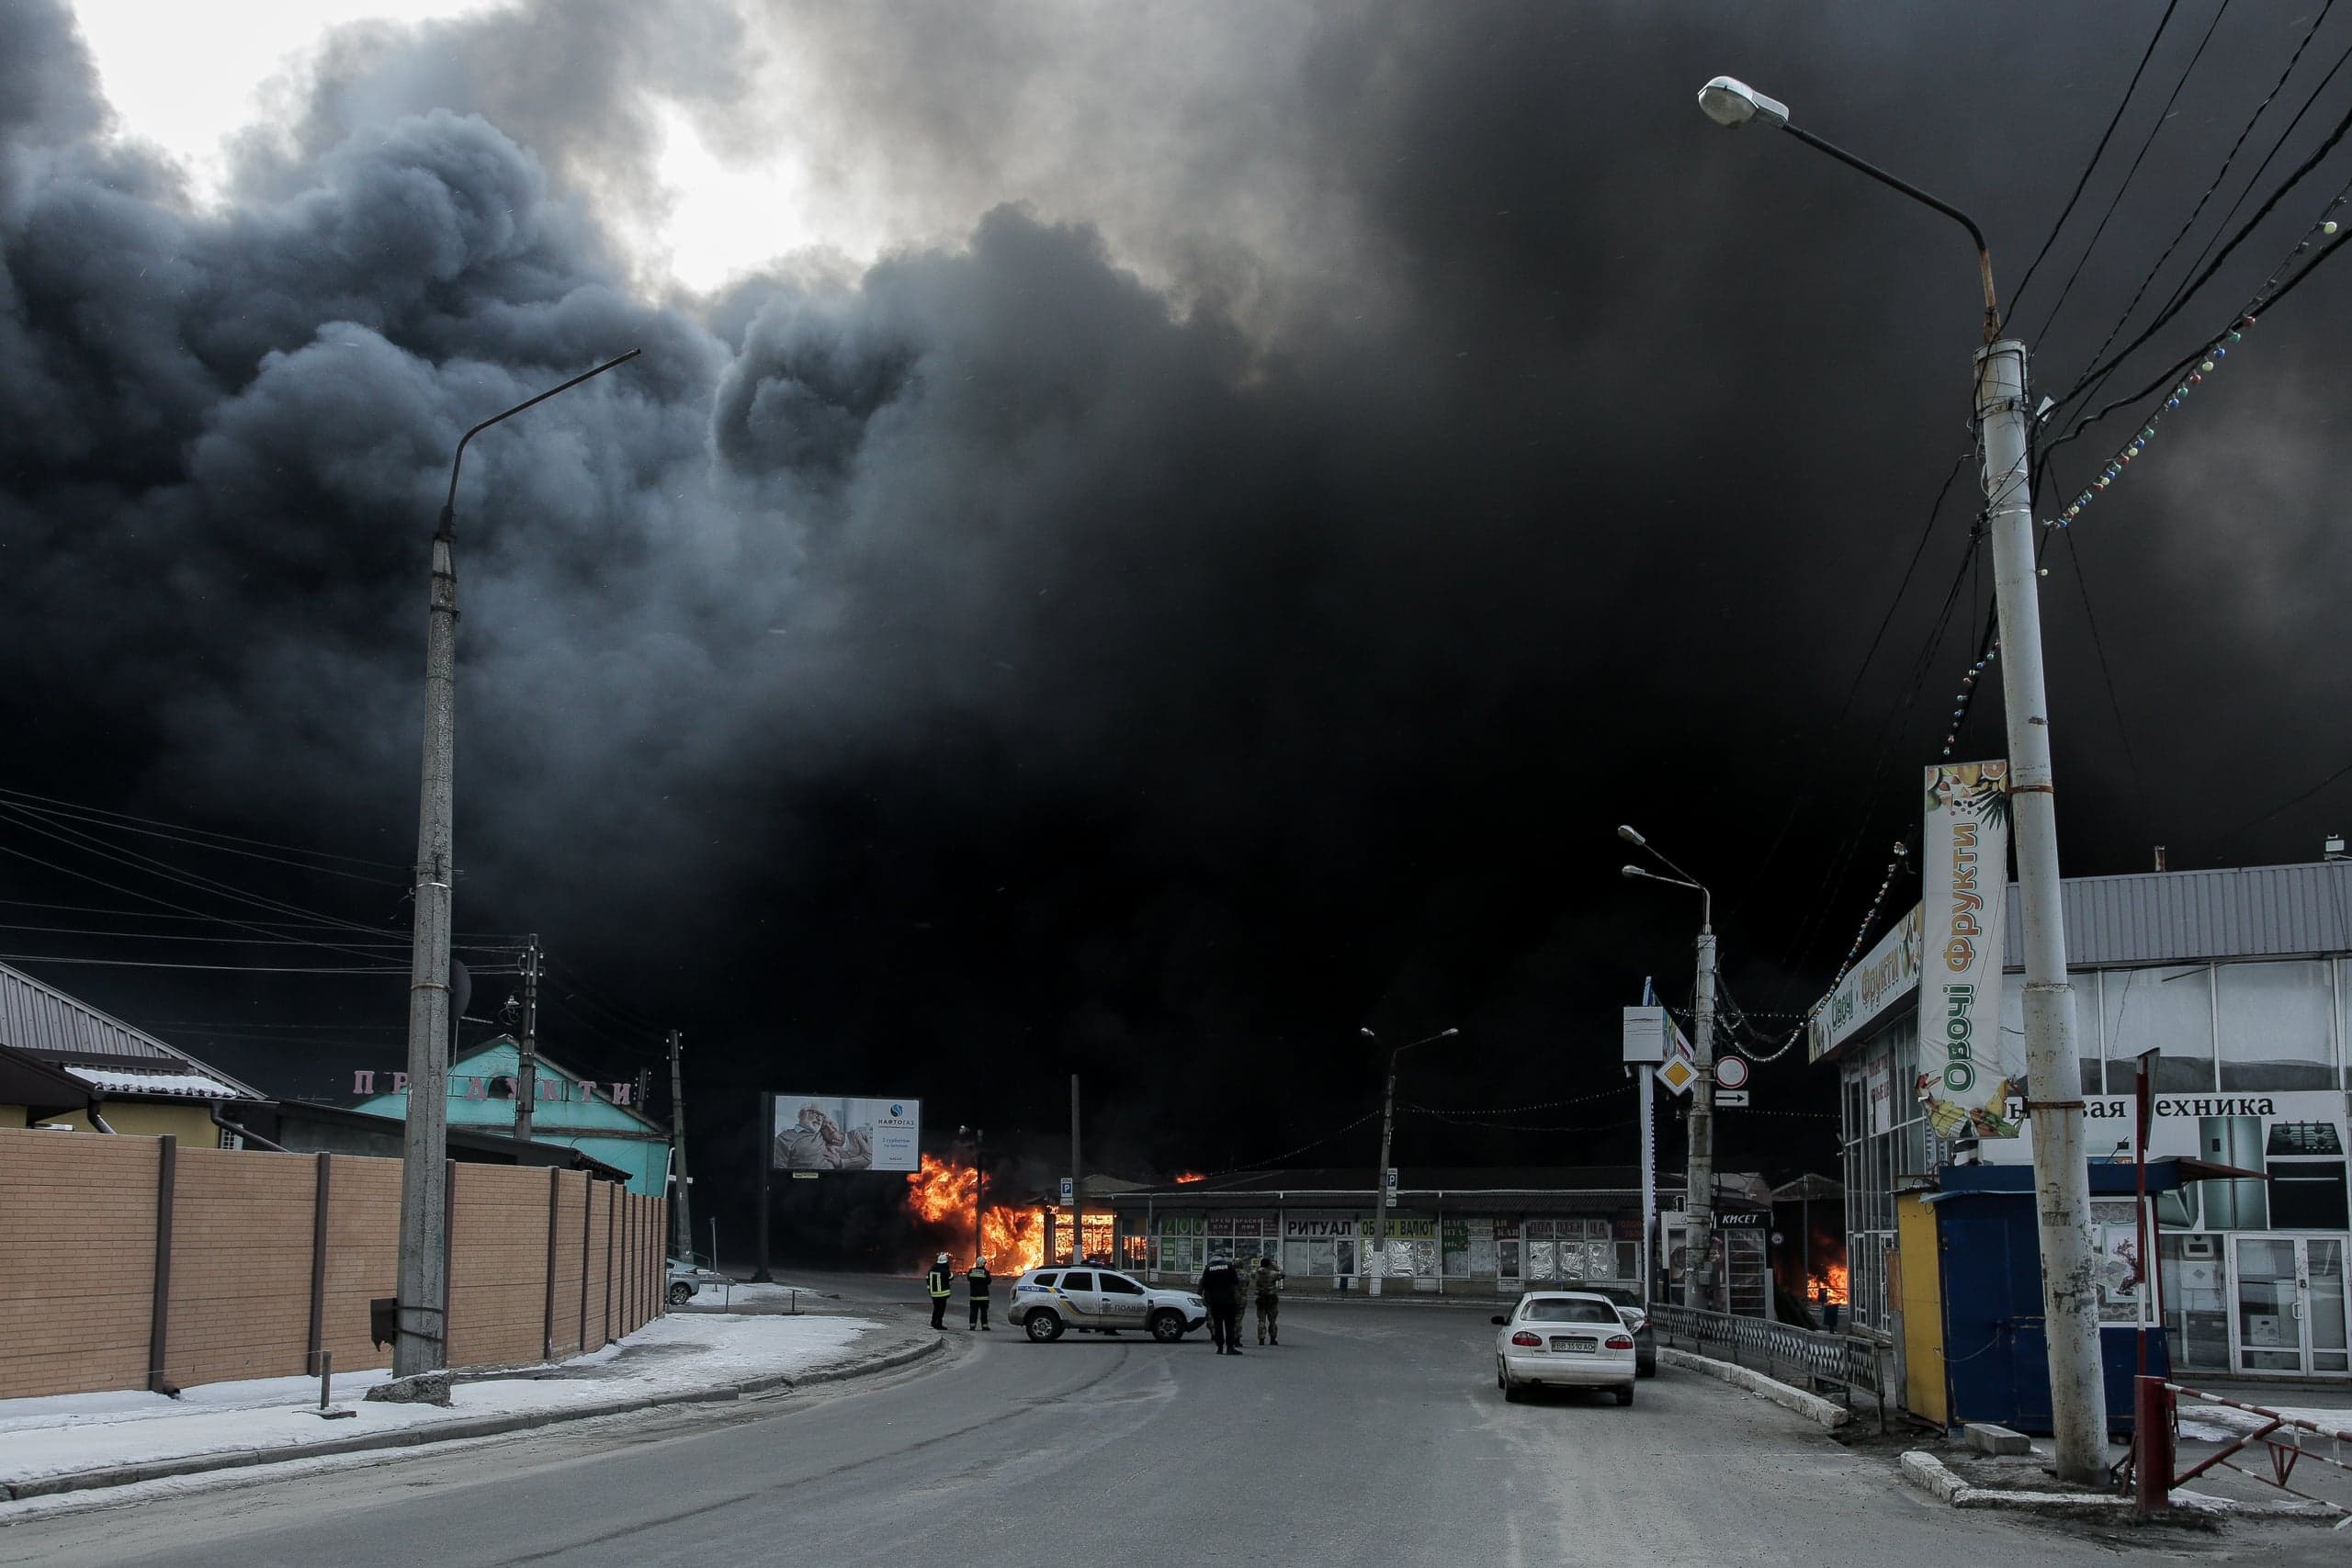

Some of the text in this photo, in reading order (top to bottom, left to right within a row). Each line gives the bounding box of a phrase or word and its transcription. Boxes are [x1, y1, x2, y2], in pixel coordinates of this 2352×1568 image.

[353, 1070, 632, 1106] ПРДУКТИ
[2155, 1097, 2276, 1117] ехника
[1722, 1214, 1759, 1224] КИСЕТ
[1287, 1220, 1351, 1235] РИТУАЛ
[1362, 1220, 1396, 1235] ОБЕН
[1114, 1304, 1147, 1313] ПОЛІЦІЯ
